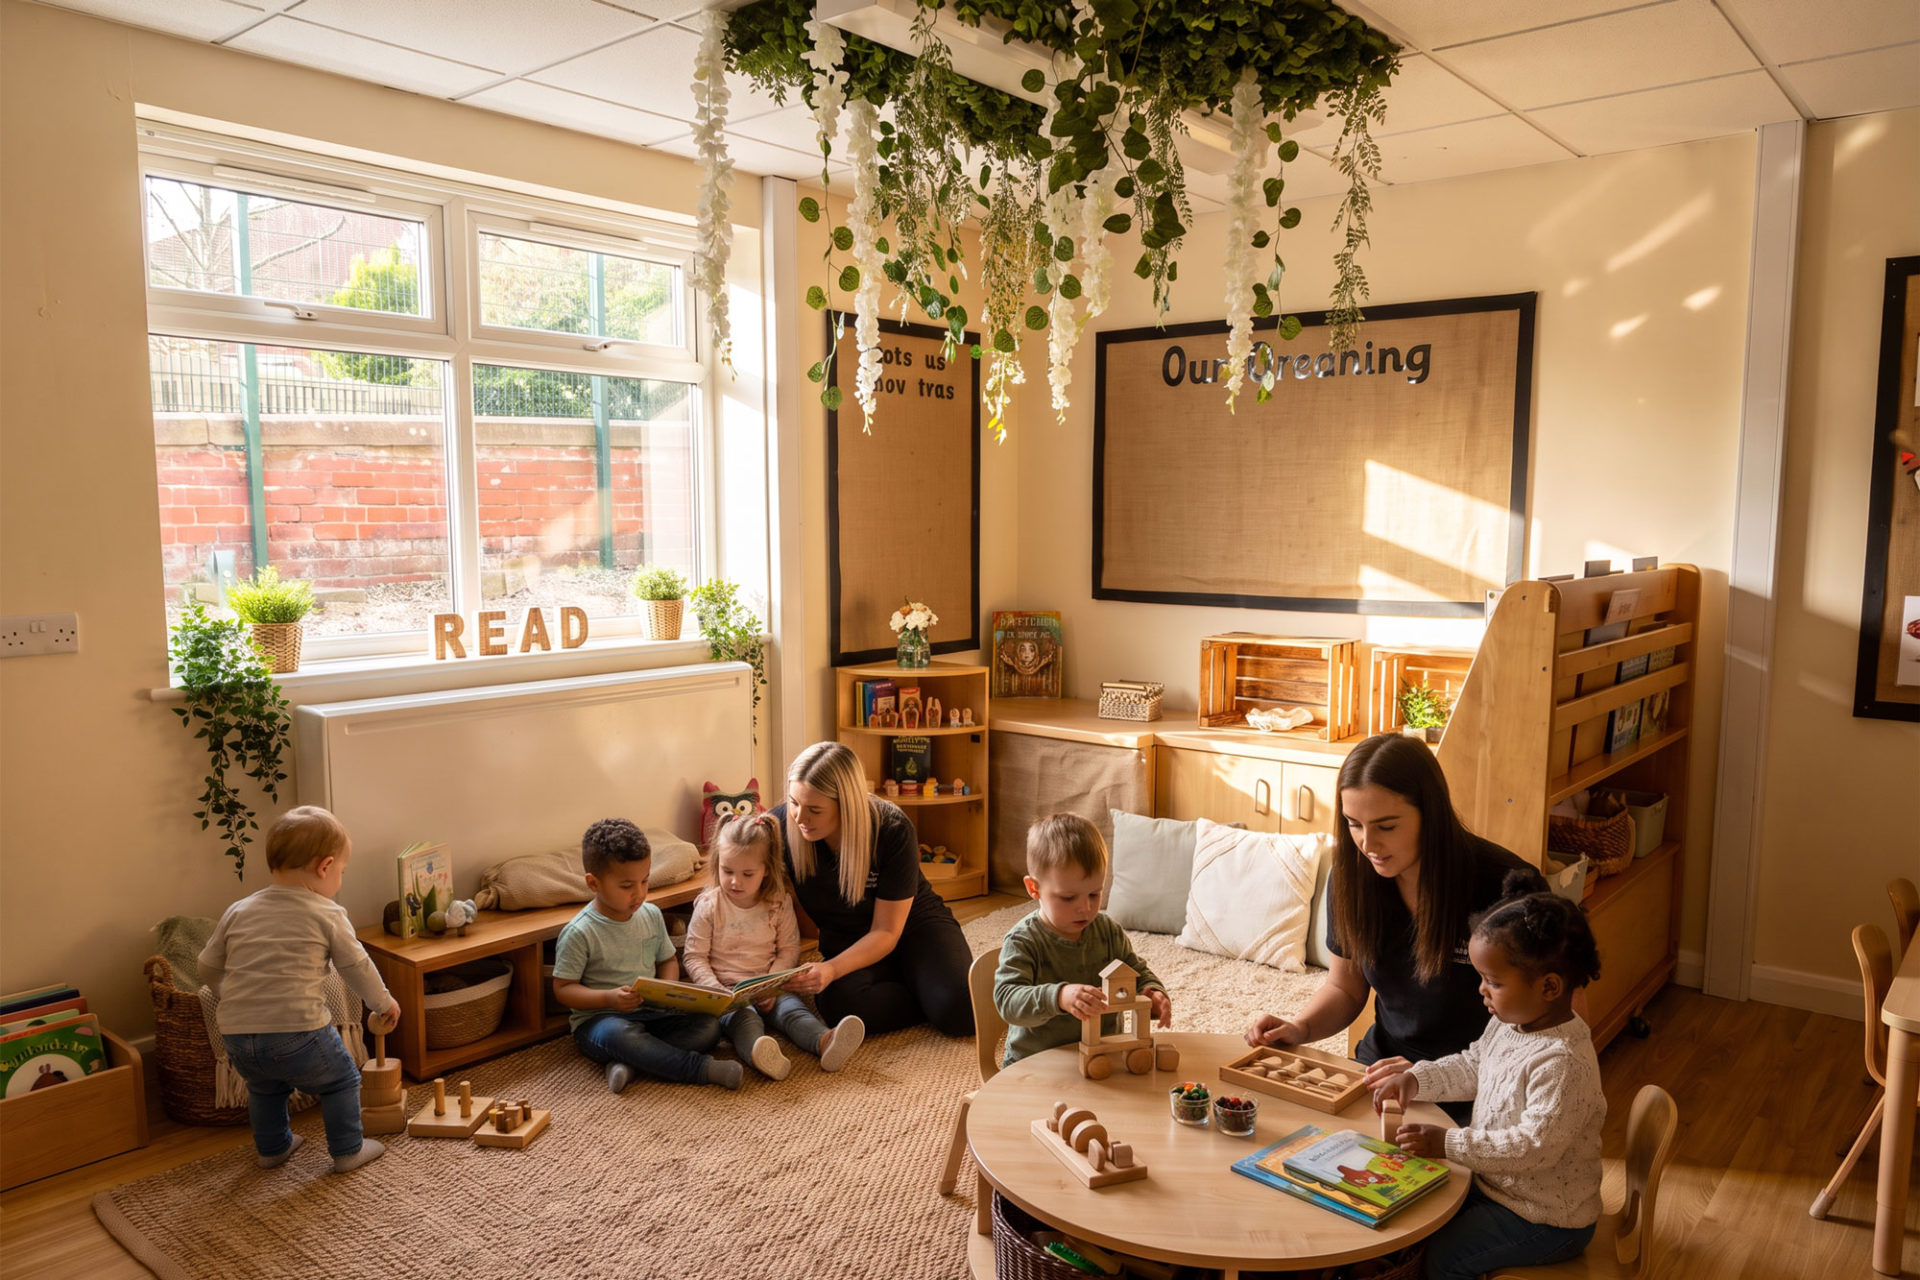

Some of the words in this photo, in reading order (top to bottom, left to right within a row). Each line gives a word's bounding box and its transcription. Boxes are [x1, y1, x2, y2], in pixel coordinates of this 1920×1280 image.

[925, 354, 946, 371] us
[1162, 345, 1228, 387] Our
[433, 606, 589, 660] READ
